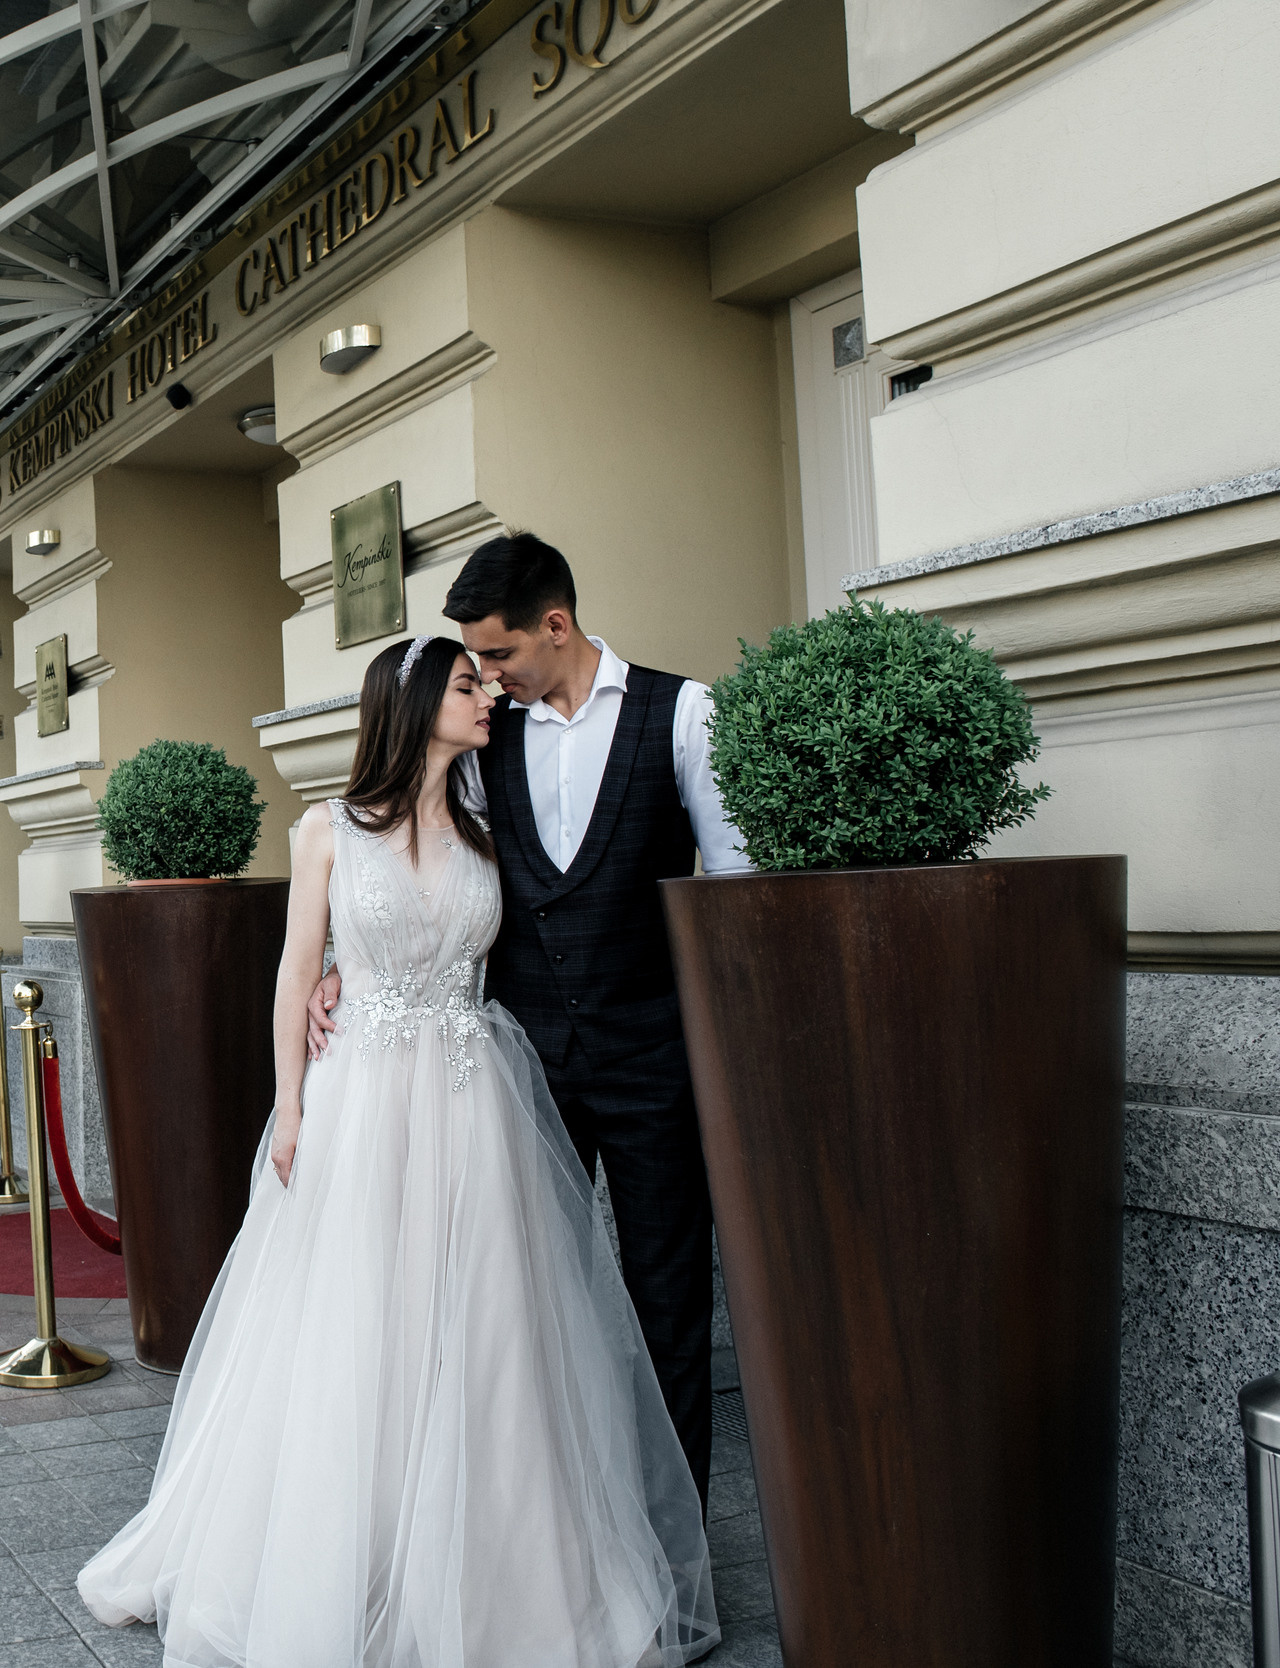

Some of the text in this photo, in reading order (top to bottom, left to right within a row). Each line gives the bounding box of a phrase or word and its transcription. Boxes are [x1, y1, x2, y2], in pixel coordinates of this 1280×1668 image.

[8, 370, 114, 496] KEMPINSKI
[126, 292, 217, 405] HOTEL
[235, 70, 495, 317] CATHEDRAL
[337, 533, 392, 589] Kempinski
